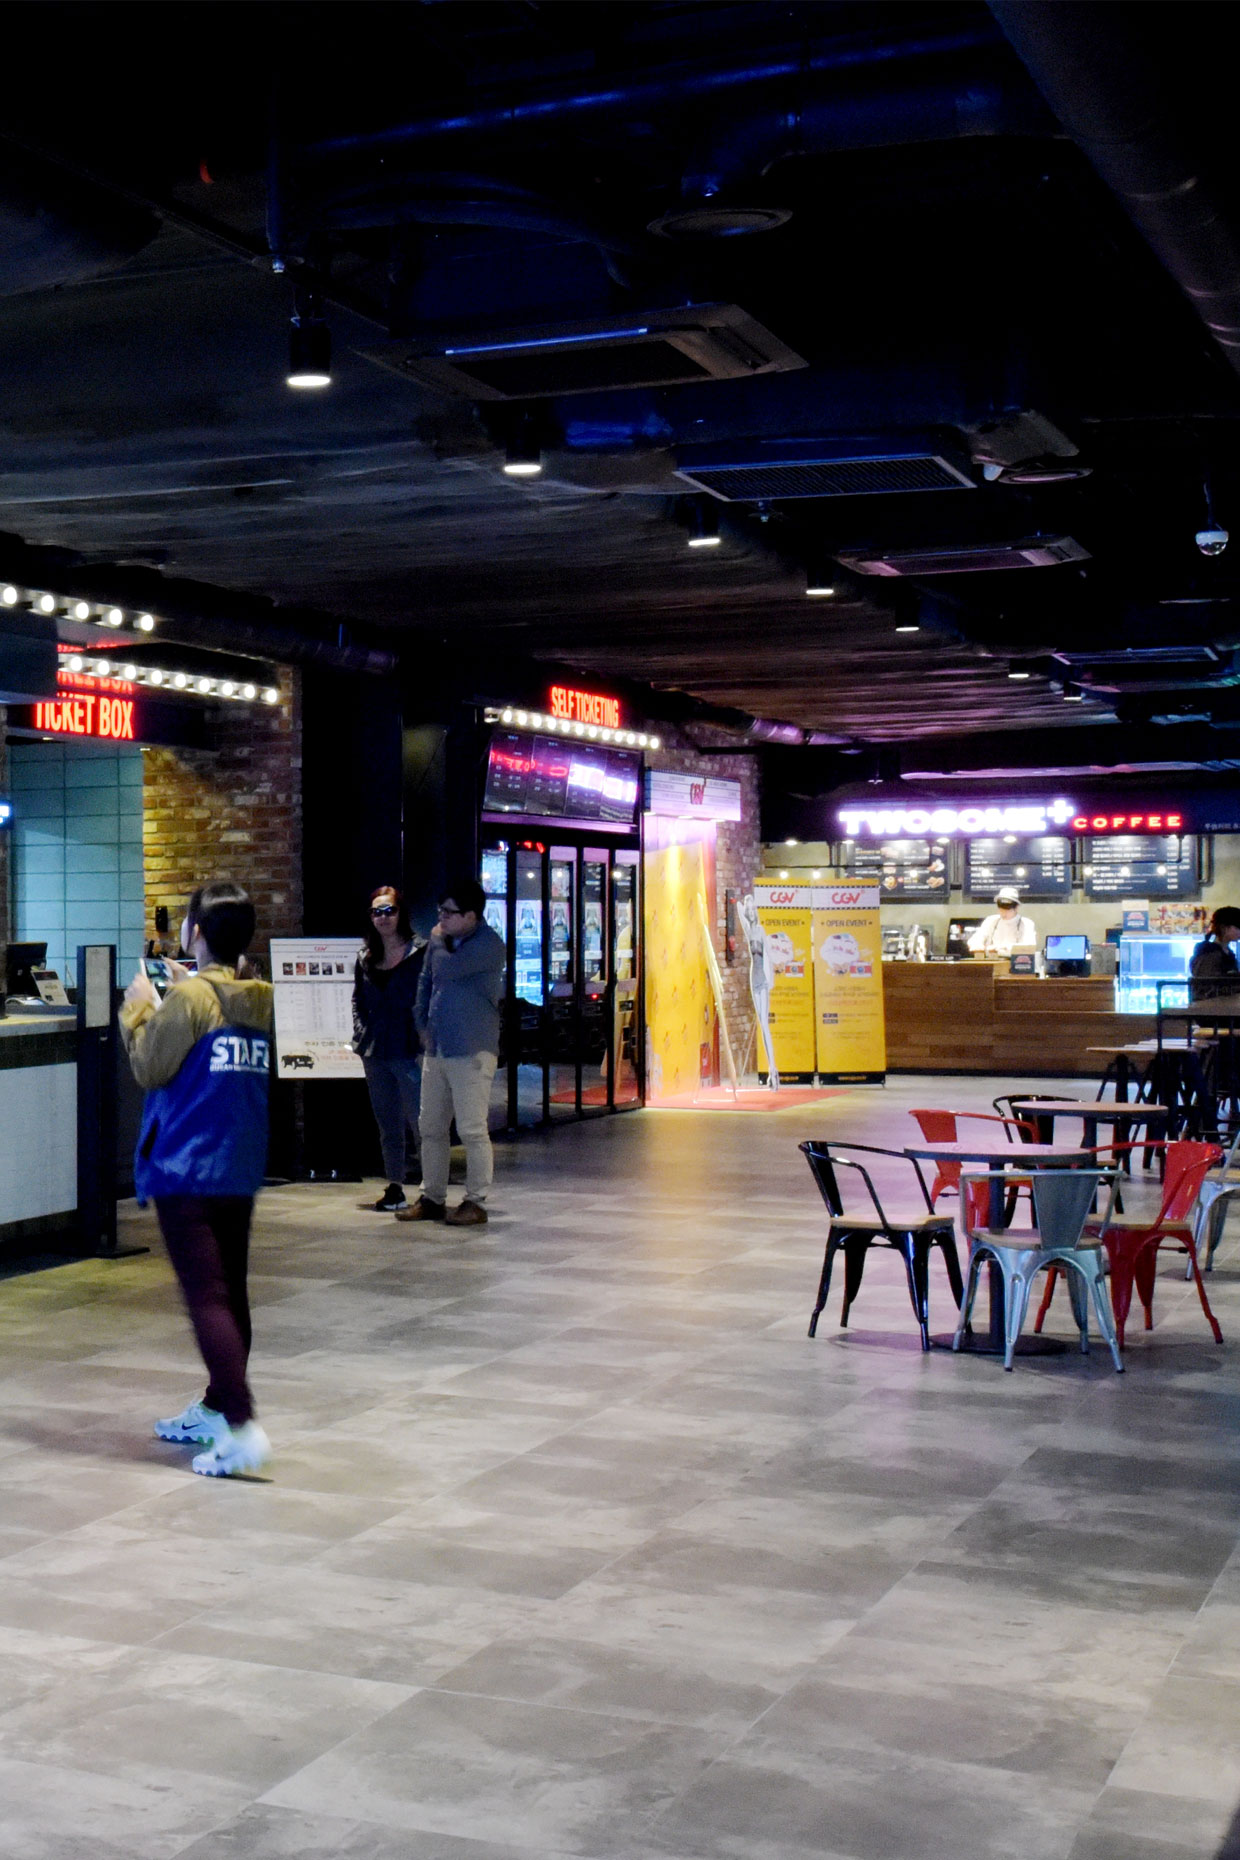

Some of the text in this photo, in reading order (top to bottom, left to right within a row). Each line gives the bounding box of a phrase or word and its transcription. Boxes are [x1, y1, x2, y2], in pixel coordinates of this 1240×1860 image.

[551, 686, 619, 728] SELF TICKETING
[36, 692, 134, 739] TICKET BOX
[1073, 815, 1181, 829] COFFEE
[770, 891, 795, 904] CGV
[831, 892, 861, 905] CGV
[782, 919, 801, 927] EVENT
[826, 919, 866, 927] OPEN EVENT
